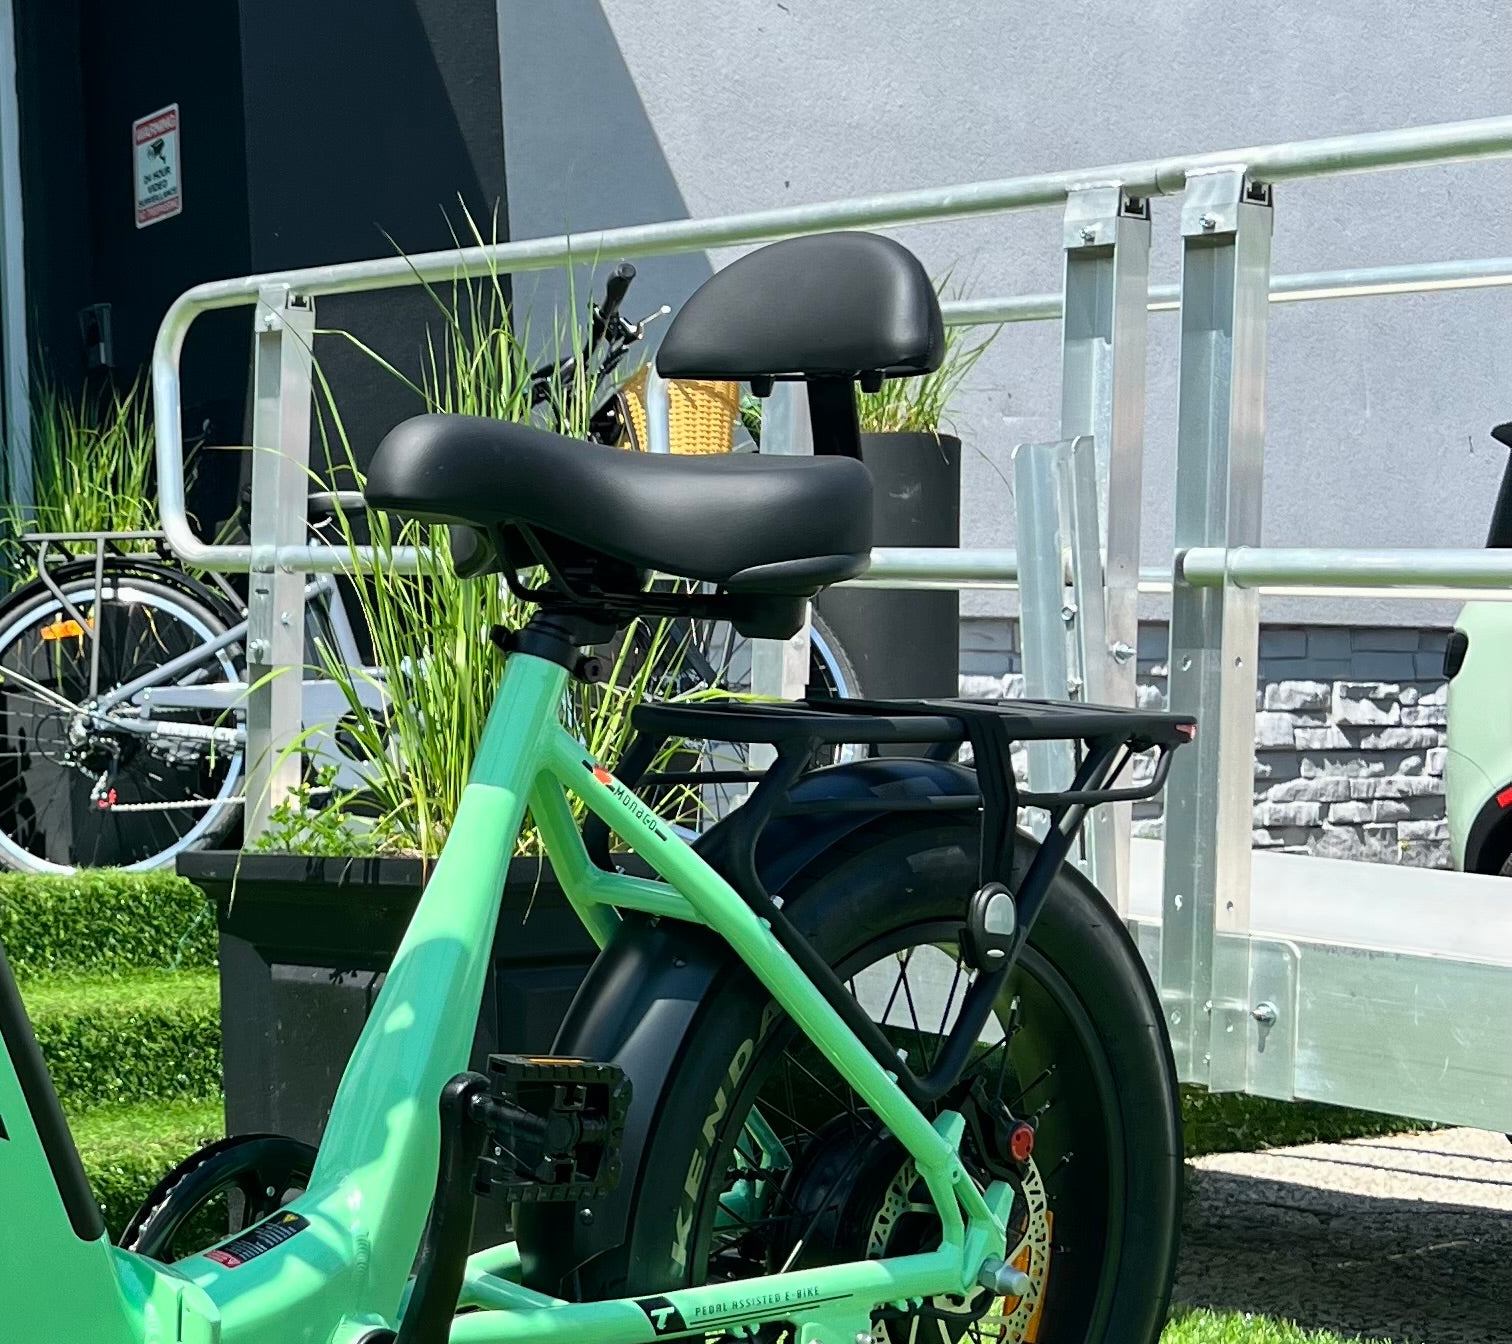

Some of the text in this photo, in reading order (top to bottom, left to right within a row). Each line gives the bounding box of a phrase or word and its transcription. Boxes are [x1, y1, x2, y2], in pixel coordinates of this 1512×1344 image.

[694, 1300, 728, 1317] PEDAL
[731, 1292, 781, 1311] ASSISTED
[784, 1285, 821, 1302] E-BIKE
